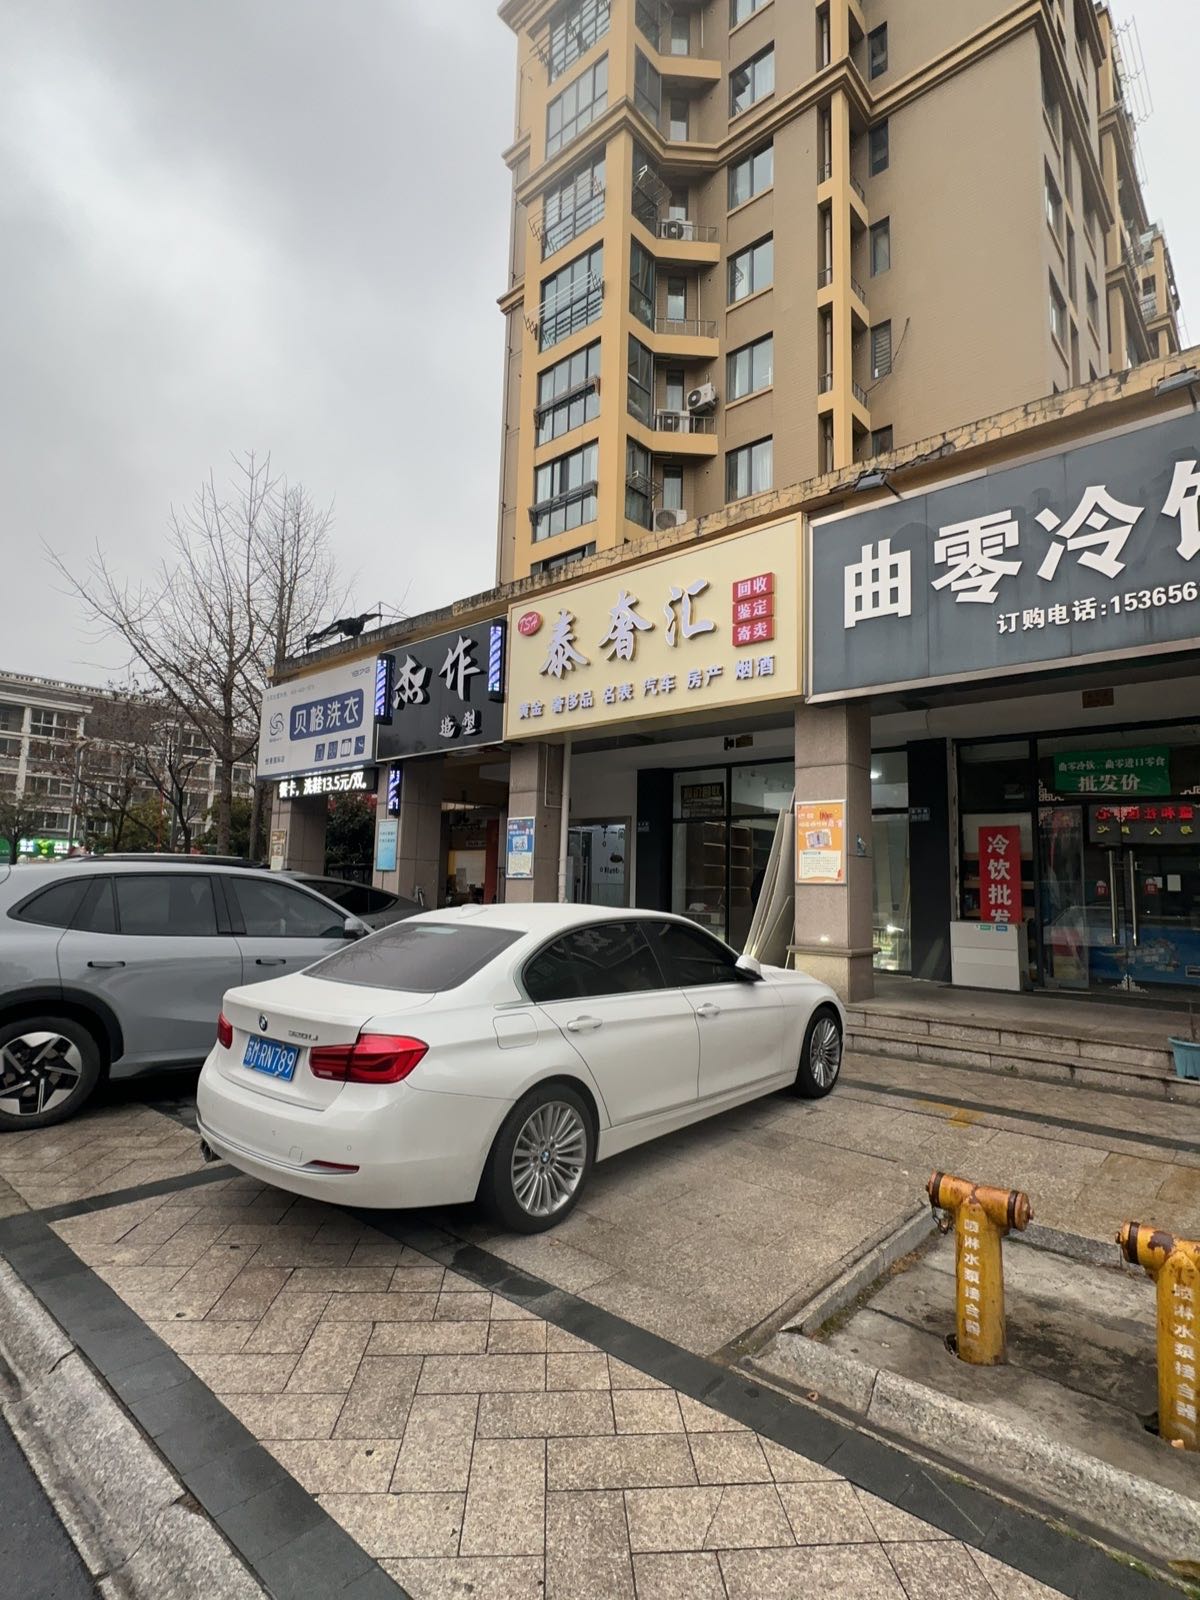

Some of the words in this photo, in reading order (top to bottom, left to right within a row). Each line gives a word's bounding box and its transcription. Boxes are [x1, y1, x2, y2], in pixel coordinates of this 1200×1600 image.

[736, 575, 768, 598] 回收
[736, 599, 768, 621] 鉴定
[996, 582, 1200, 634] 订购电话:153656
[539, 579, 716, 678] 泰奢汇
[736, 621, 768, 643] 寄卖
[519, 702, 546, 720] 黄金
[551, 690, 594, 714] 奢侈品
[603, 682, 634, 704] 名表
[643, 674, 677, 696] 汽车
[687, 666, 724, 689] 房产
[735, 655, 776, 681] 烟酒
[294, 696, 360, 735] 贝格洗衣
[1078, 774, 1141, 793] 批发价
[986, 833, 1013, 923] 冷饮批发
